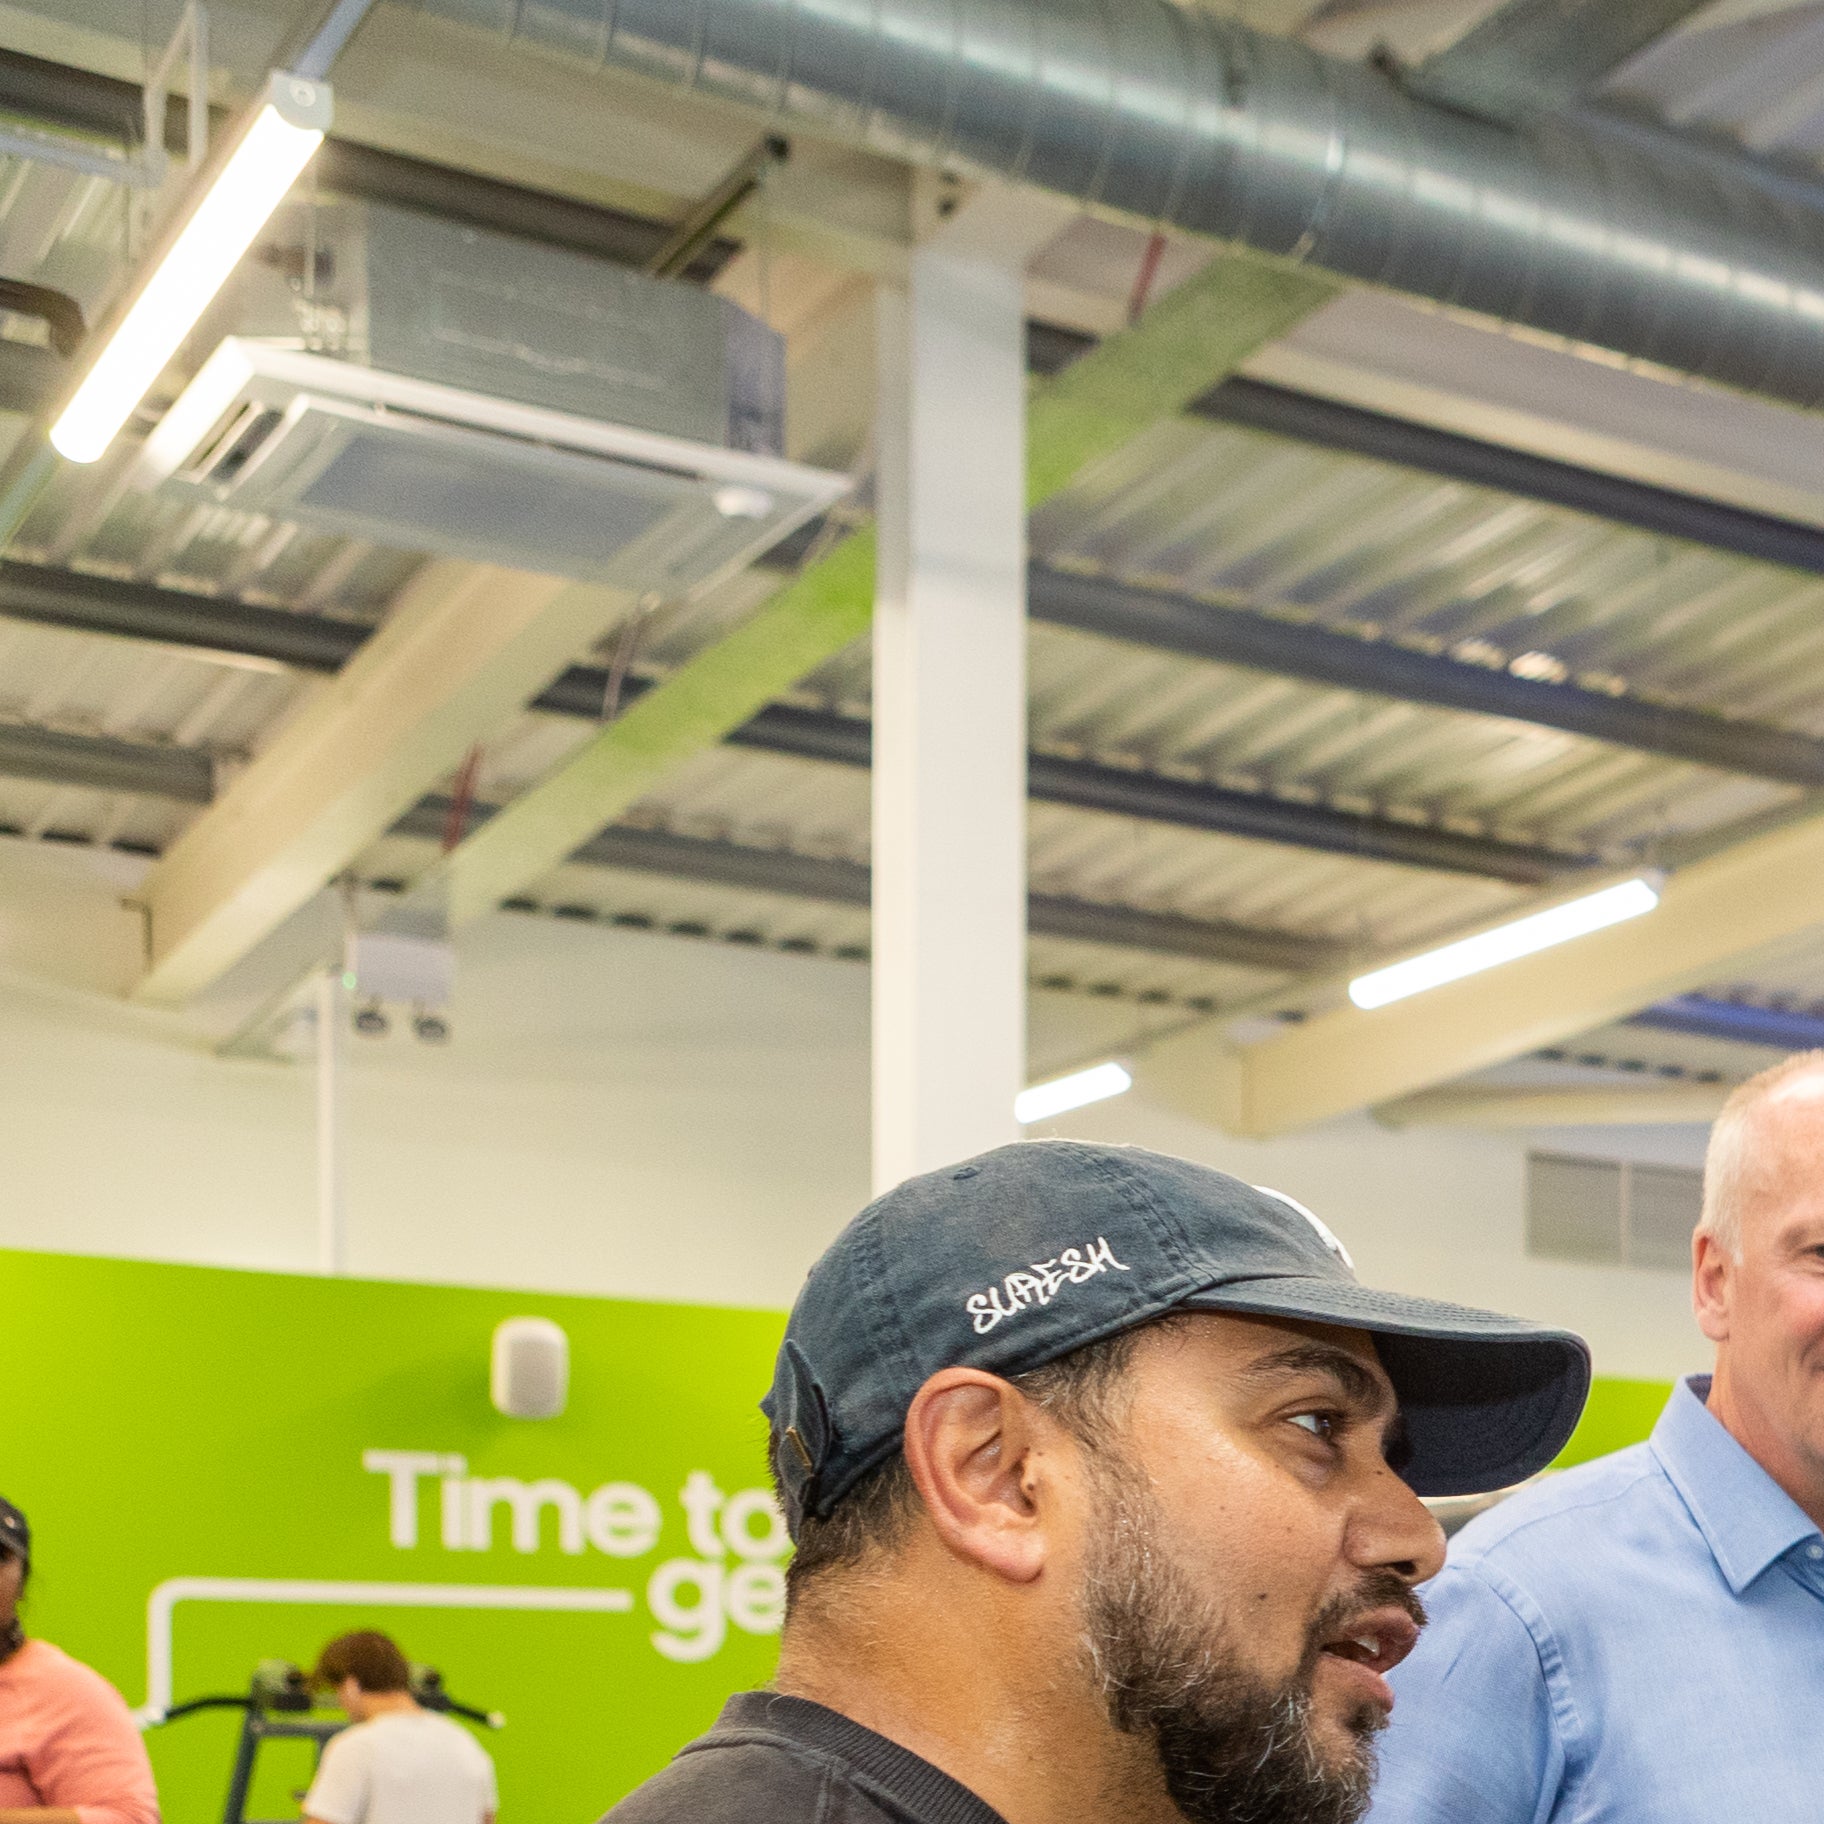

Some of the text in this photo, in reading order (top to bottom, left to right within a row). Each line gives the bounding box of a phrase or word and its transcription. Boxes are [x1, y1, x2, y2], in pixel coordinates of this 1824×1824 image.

[362, 1448, 793, 1560] Time to
[647, 1556, 788, 1663] ge
